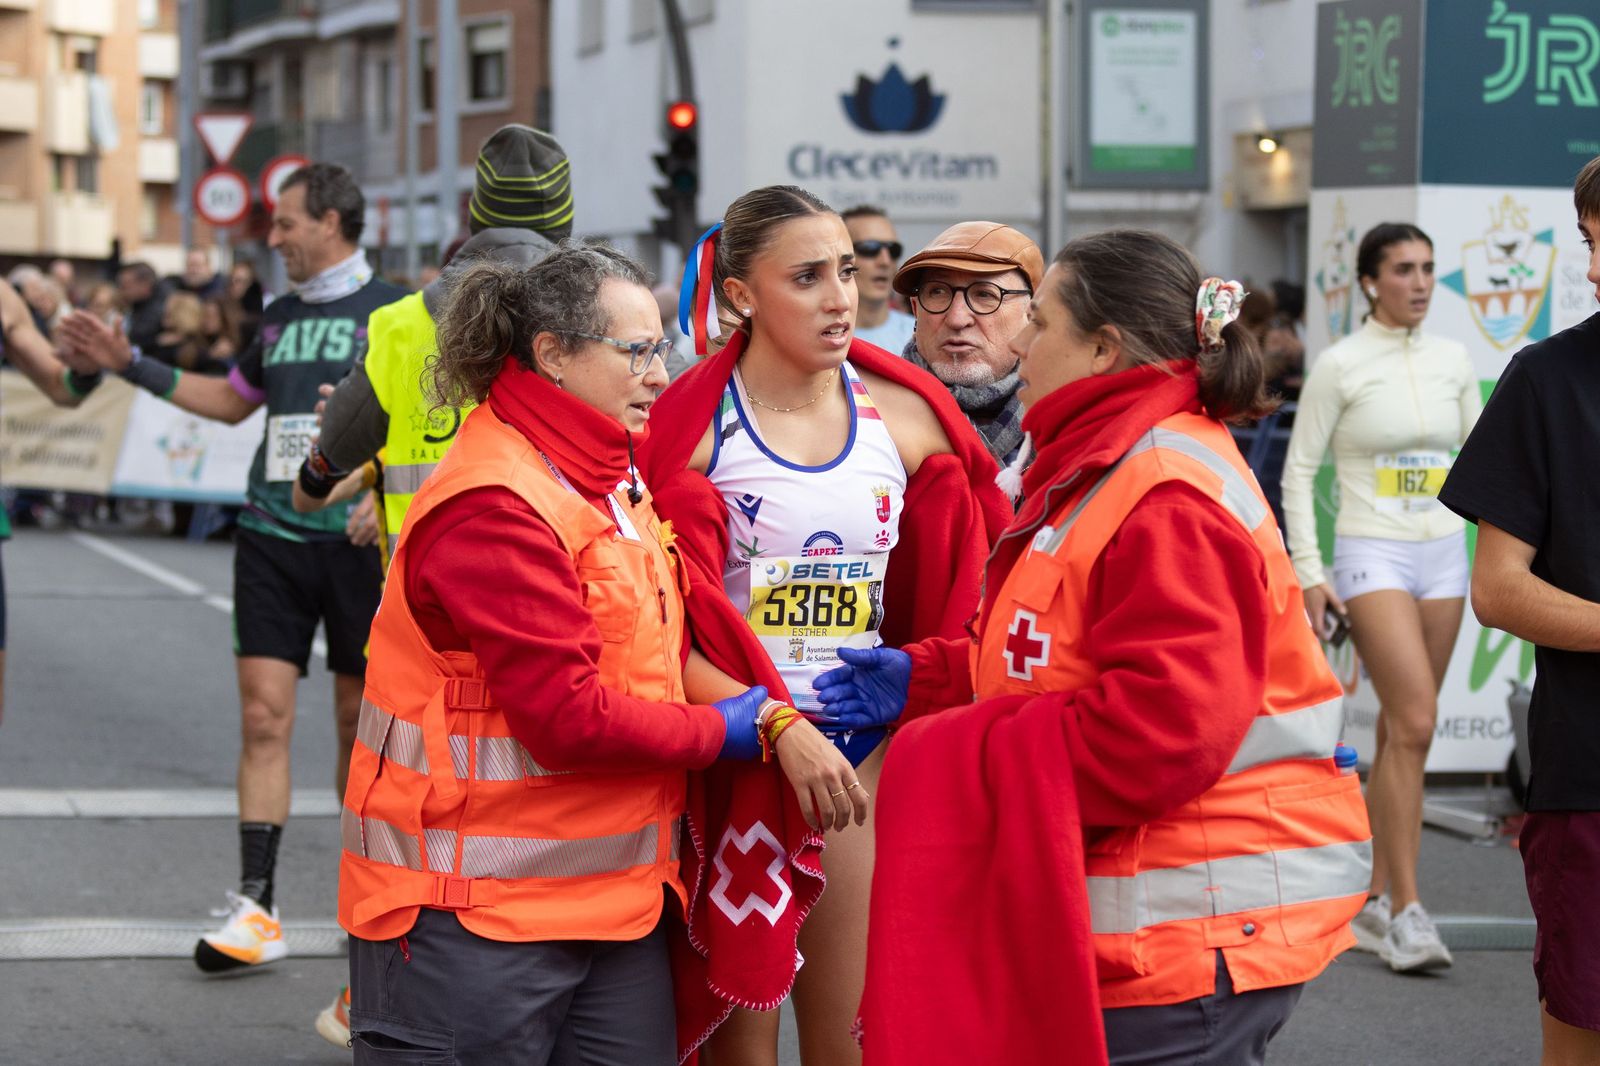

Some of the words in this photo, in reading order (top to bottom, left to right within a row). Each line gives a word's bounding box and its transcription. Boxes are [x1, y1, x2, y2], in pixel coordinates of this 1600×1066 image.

[787, 143, 998, 181] CleceVitam
[411, 449, 440, 460] SAL
[1397, 469, 1429, 493] 162
[808, 547, 838, 557] CAPEX
[791, 561, 873, 580] SETEL
[763, 584, 858, 627] 5368
[792, 628, 828, 637] ESTHER
[806, 646, 837, 655] Ayuntamie
